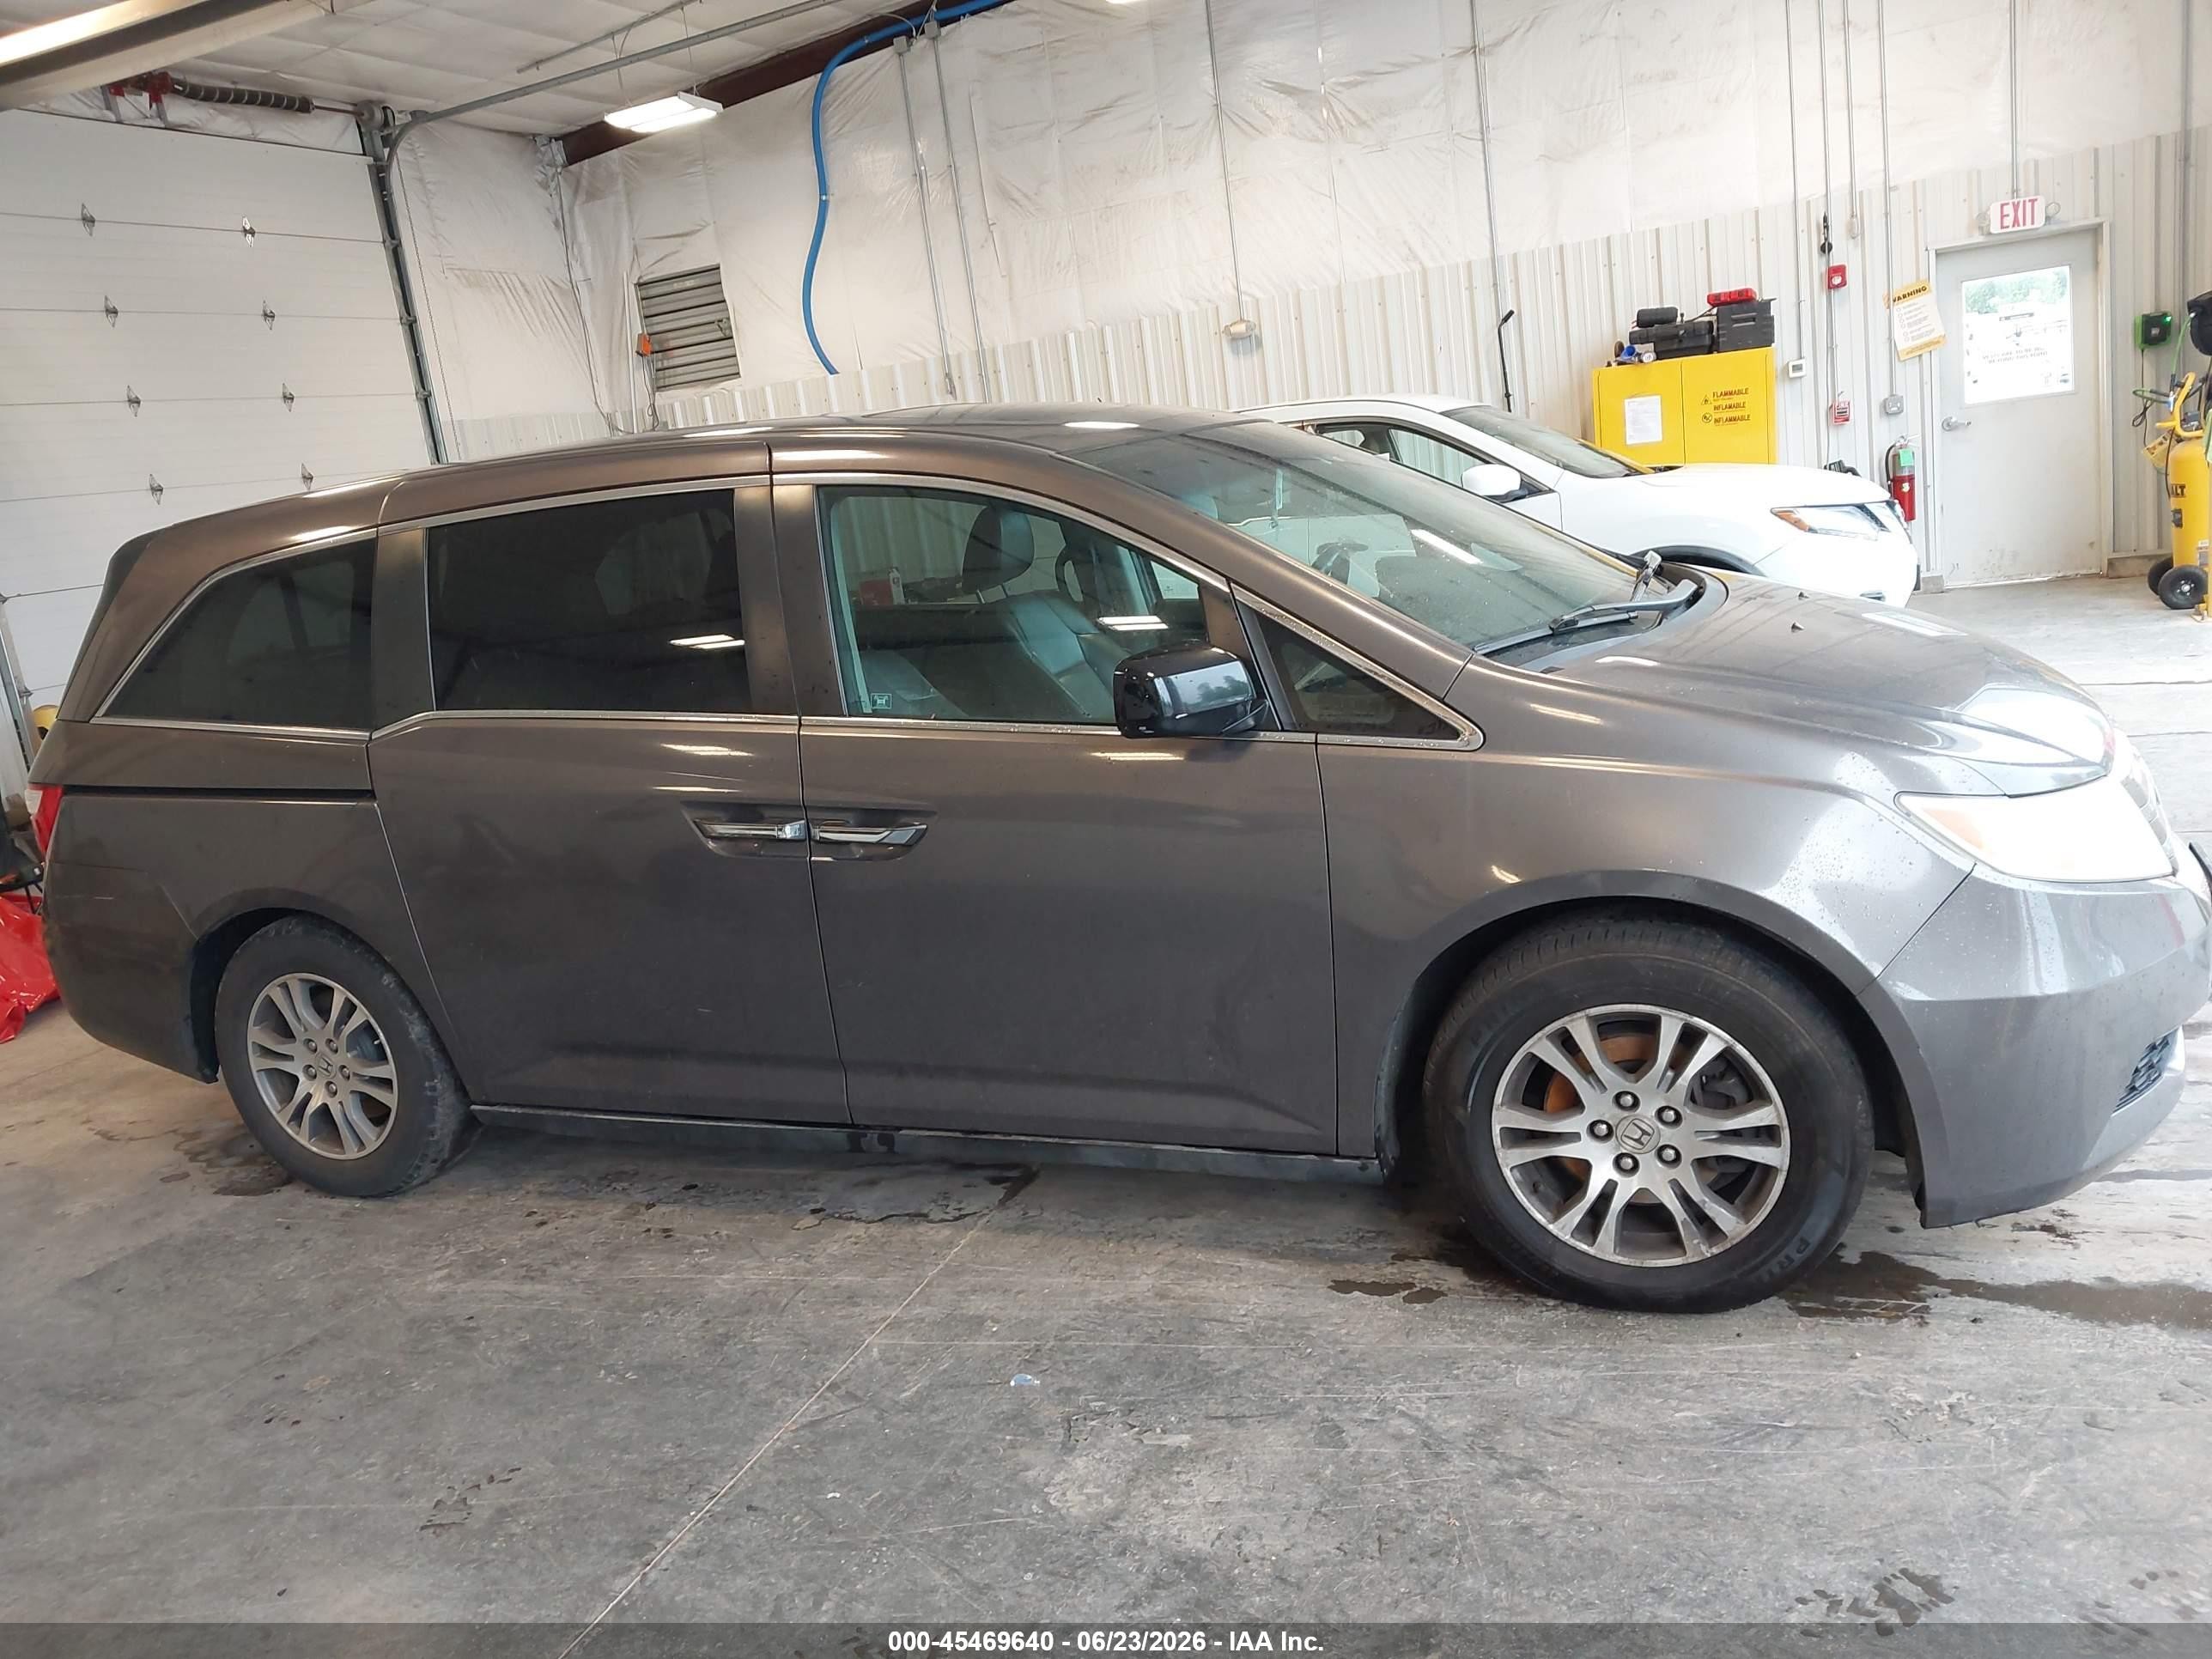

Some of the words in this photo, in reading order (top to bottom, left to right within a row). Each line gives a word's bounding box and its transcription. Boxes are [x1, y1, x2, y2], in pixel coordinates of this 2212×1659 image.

[2000, 198, 2039, 230] EXIT
[1712, 387, 1749, 398] FLAMMABLE
[1713, 401, 1746, 411] INFLAMABLE
[1713, 414, 1751, 425] INFLAMMABLE
